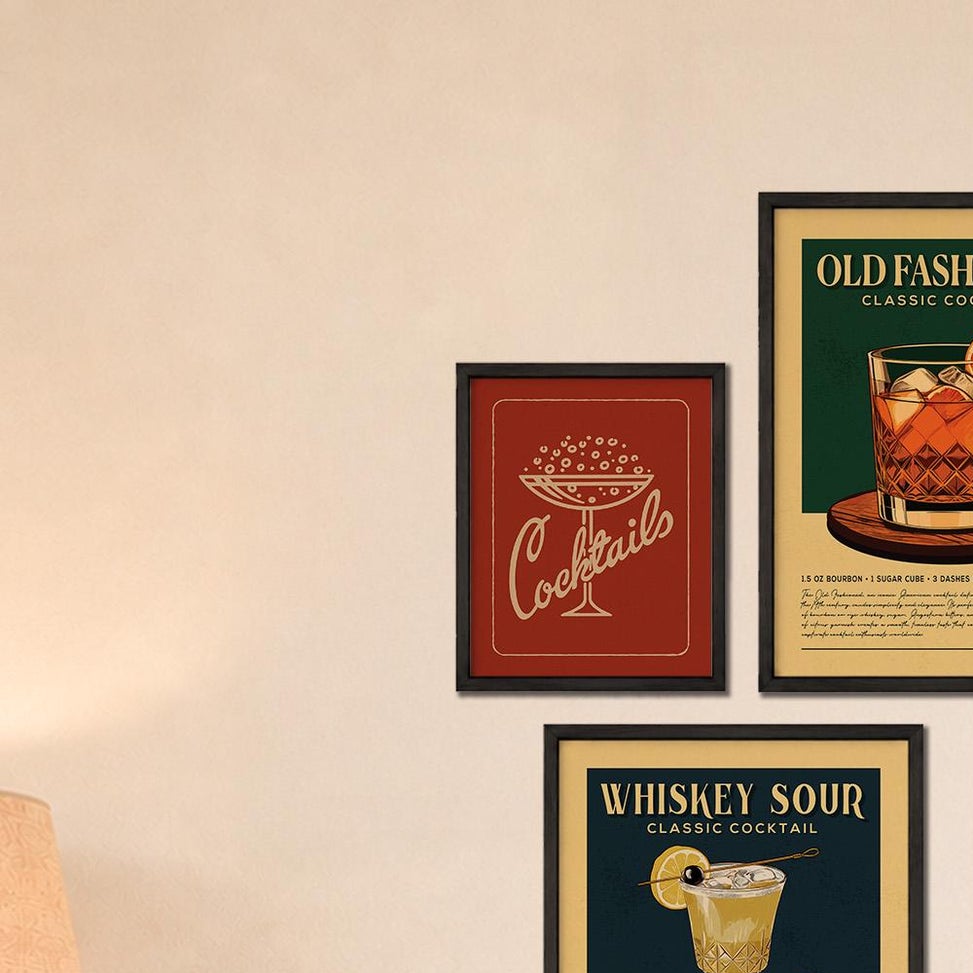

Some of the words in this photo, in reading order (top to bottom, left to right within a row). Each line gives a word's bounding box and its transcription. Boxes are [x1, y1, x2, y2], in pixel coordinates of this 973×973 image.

[816, 254, 887, 287] OLD
[862, 294, 937, 306] CLASSIC
[509, 488, 674, 620] Cocktails
[600, 783, 753, 819] WHISKEY
[770, 783, 865, 819] SOUR
[647, 822, 722, 834] CLASSIC
[729, 822, 818, 834] COCKTAIL
